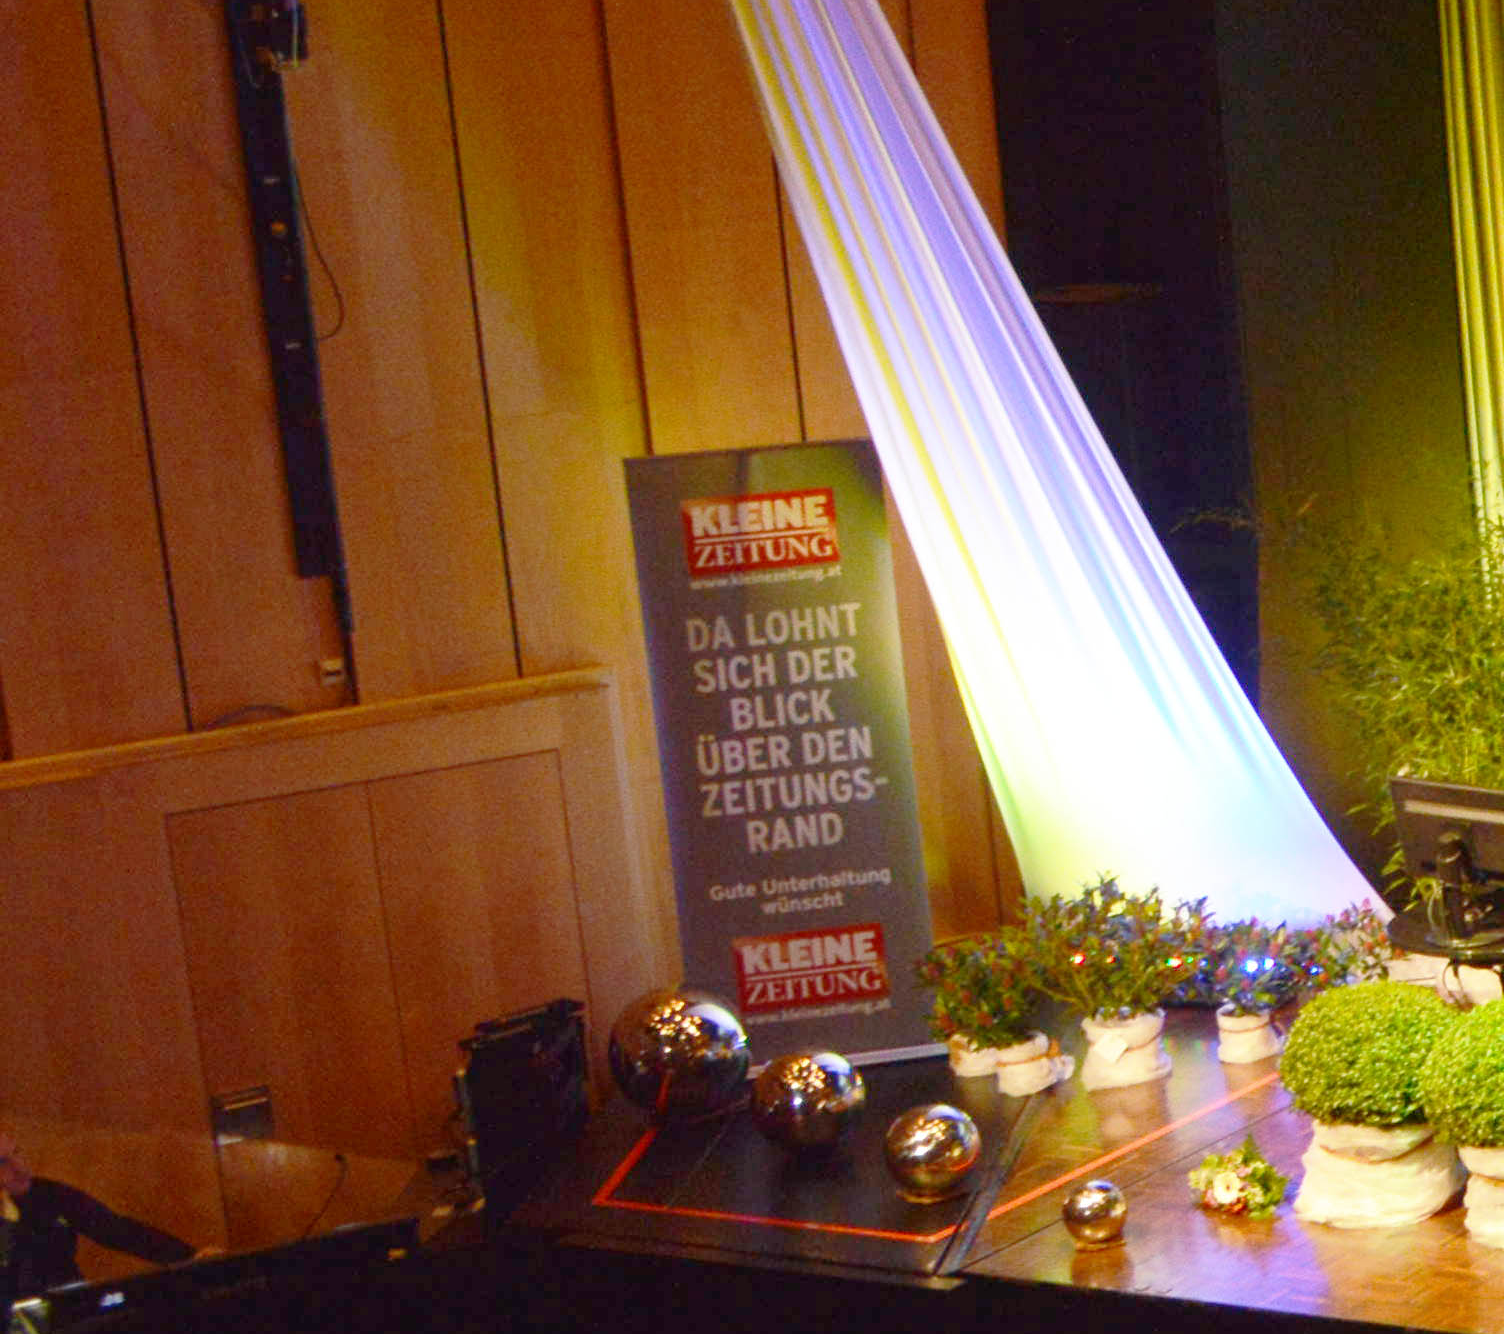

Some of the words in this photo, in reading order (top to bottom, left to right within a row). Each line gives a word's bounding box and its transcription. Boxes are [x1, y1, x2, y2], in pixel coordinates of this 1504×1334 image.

[690, 494, 829, 538] KLEINE
[693, 534, 834, 569] ZEITUNG
[686, 614, 734, 653] DA
[747, 602, 861, 646] LOHNT
[694, 653, 778, 694] SICH
[788, 645, 858, 686] DER
[730, 687, 836, 734] BLICK
[696, 731, 792, 777] ÜBER
[802, 726, 873, 767] DEN
[702, 768, 889, 818] ZEITUNGS-
[747, 812, 845, 854] RAND
[709, 880, 757, 904] Gute
[762, 866, 893, 896] Unterhaltung
[761, 888, 845, 916] wünscht
[741, 930, 878, 975] KLEINE
[746, 967, 882, 1005] ZEITUNG
